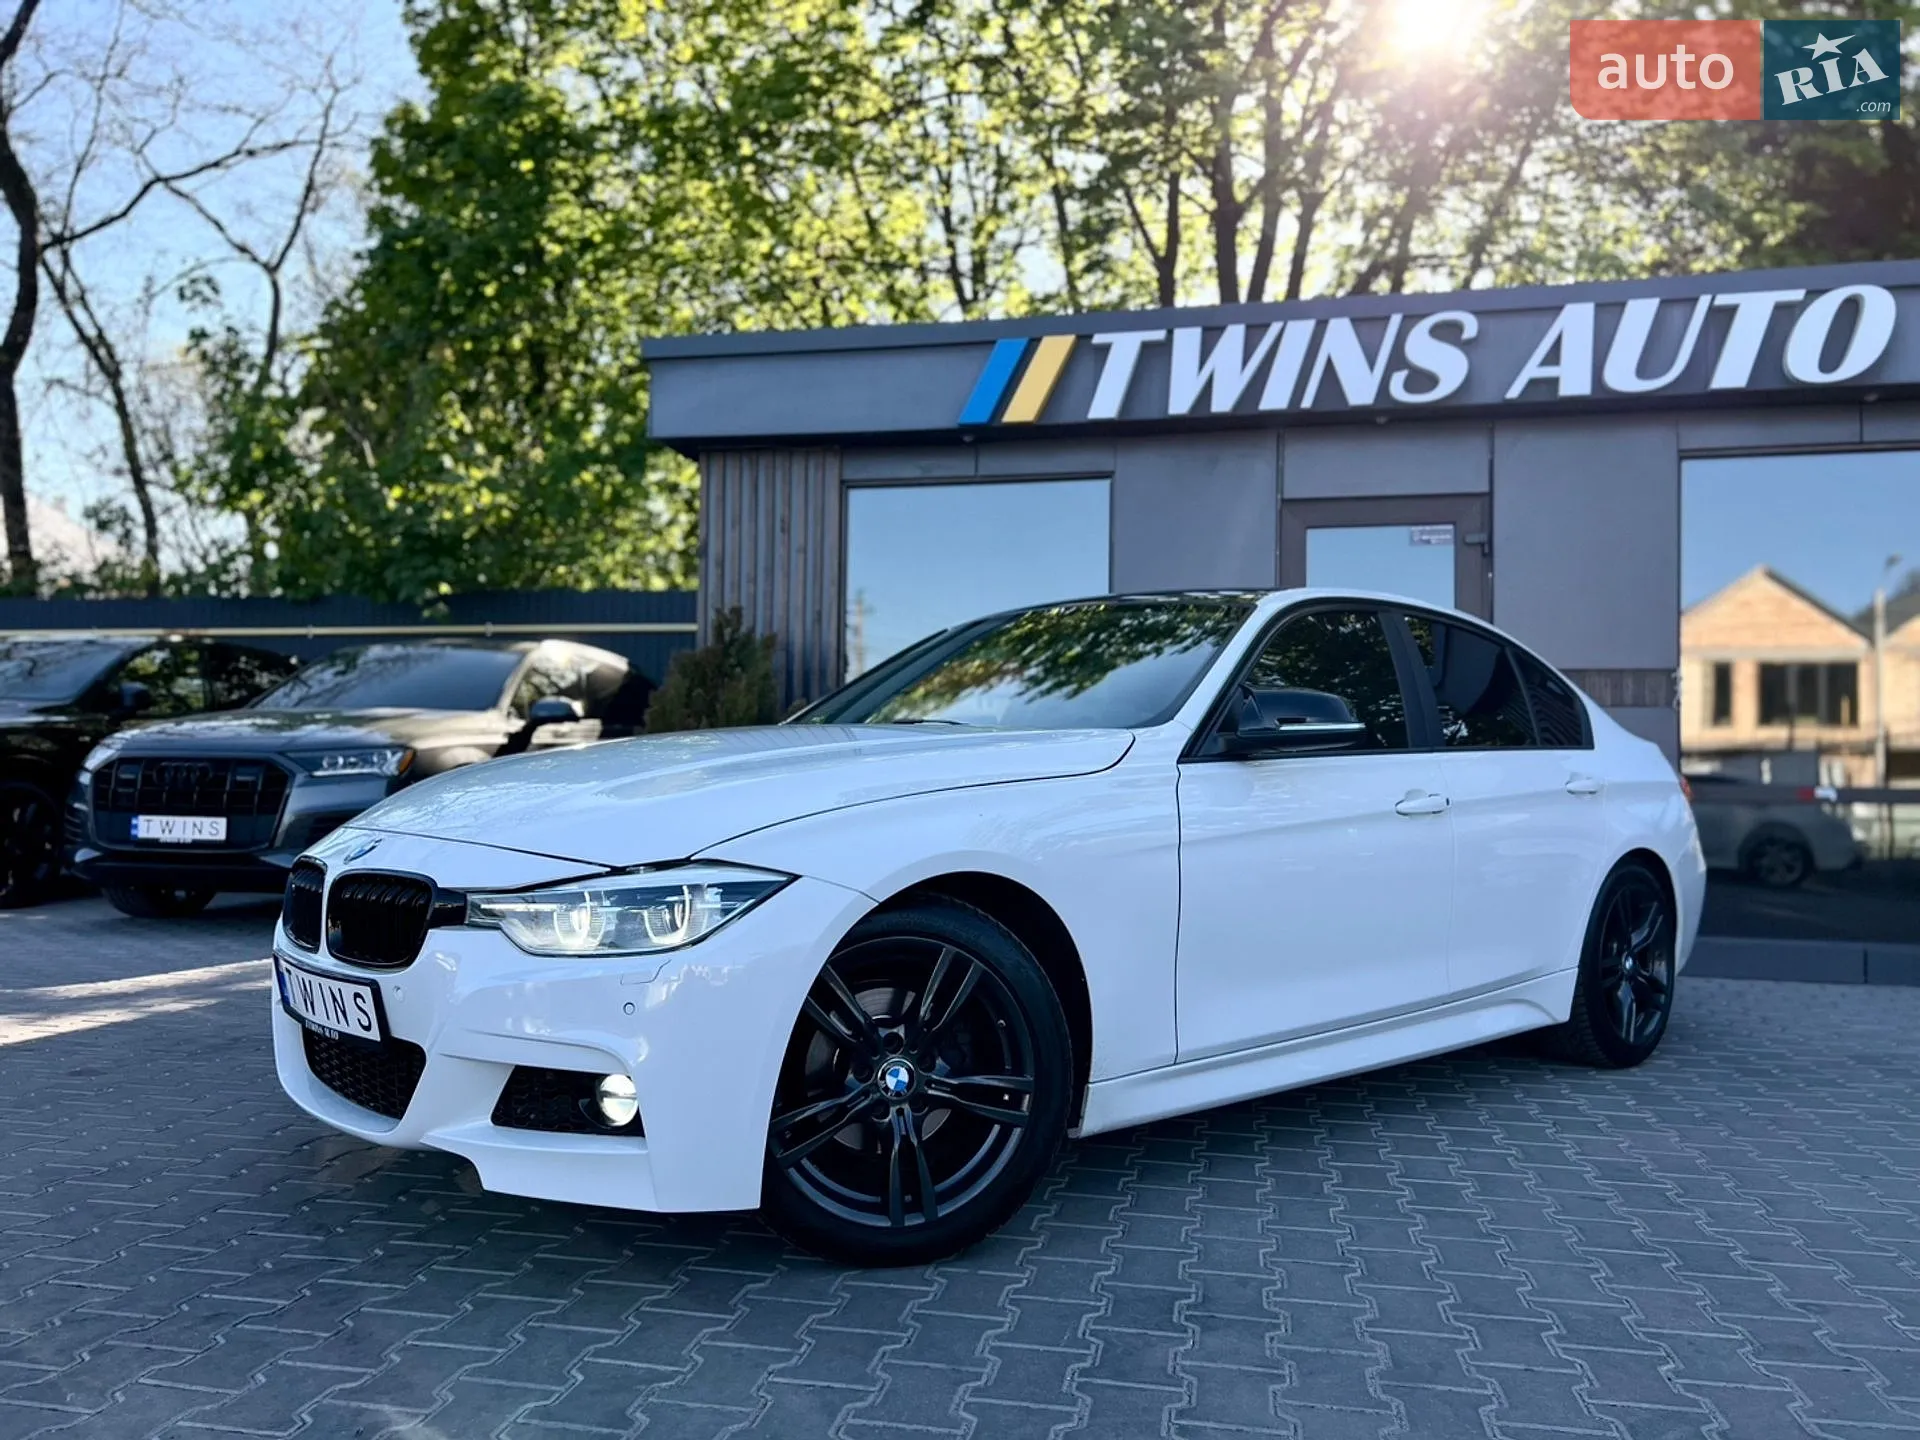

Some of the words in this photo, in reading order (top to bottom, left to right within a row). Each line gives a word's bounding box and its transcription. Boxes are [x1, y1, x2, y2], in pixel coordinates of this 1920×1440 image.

[1087, 310, 1478, 421] TWINS
[1504, 284, 1898, 400] AUTO
[143, 818, 220, 837] TWINS
[285, 967, 372, 1033] TWINS
